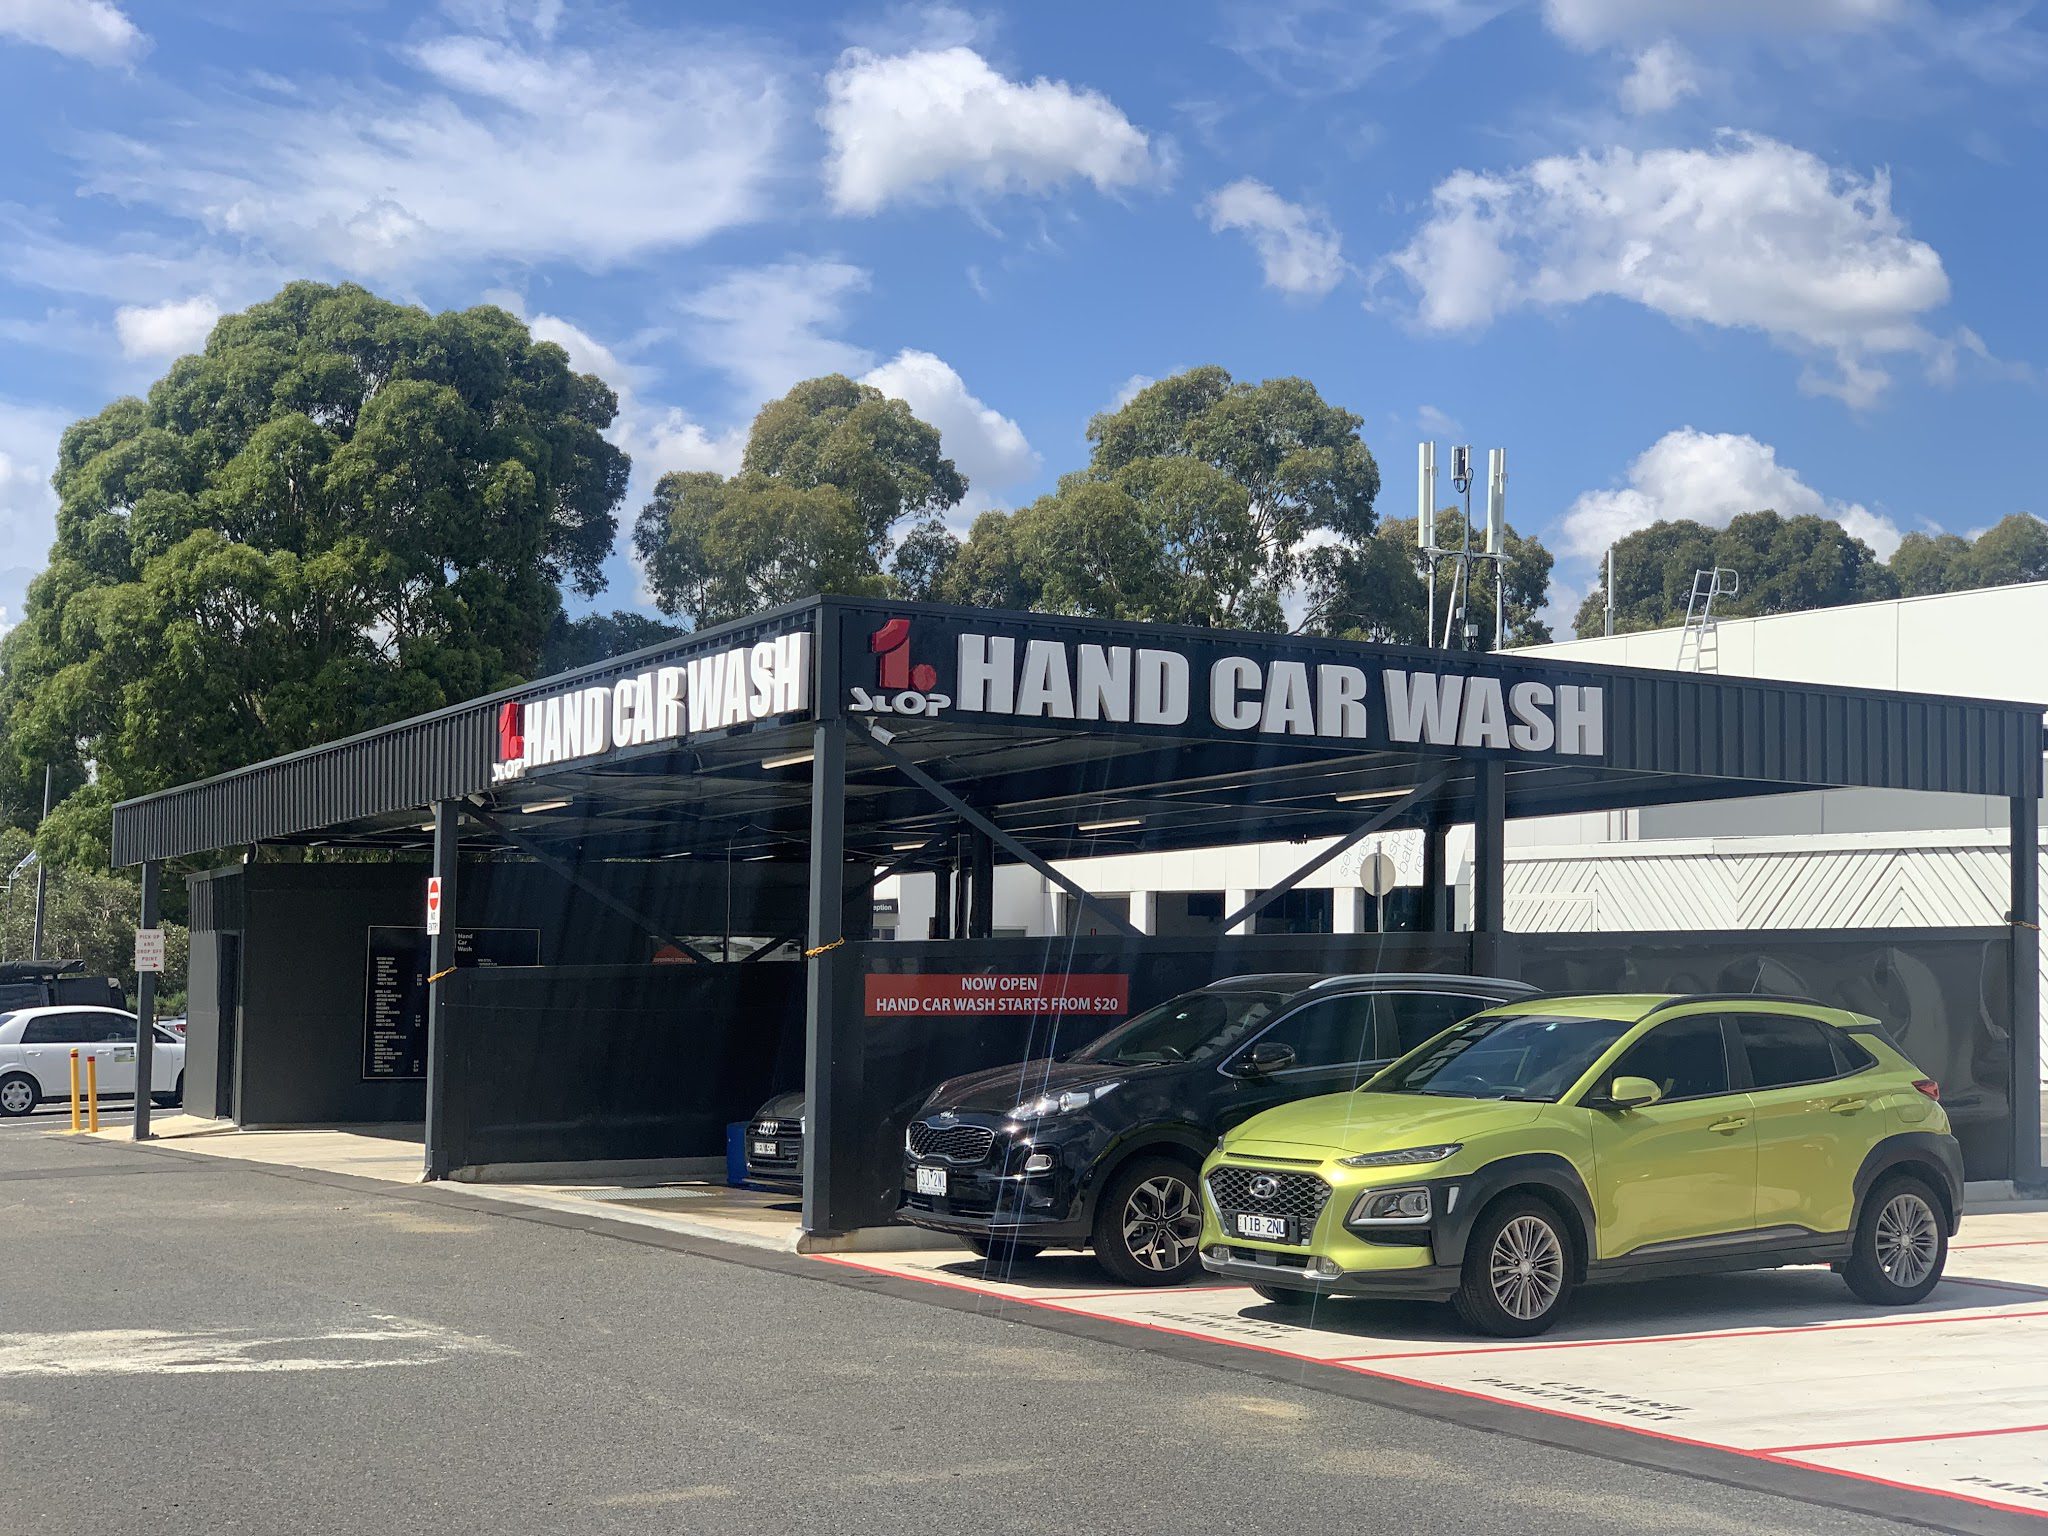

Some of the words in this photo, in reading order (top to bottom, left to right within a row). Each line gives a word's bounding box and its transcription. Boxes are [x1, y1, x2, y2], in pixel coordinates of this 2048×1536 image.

[523, 686, 613, 768] HAND
[611, 666, 688, 749] CAR
[687, 632, 811, 733] WASH
[955, 633, 1190, 725] HAND
[1209, 656, 1367, 739] CAR
[1382, 668, 1604, 756] WASH
[873, 904, 892, 912] eption
[961, 977, 998, 991] NOW
[999, 977, 1038, 991] OPEN
[876, 997, 920, 1012] HAND
[922, 997, 951, 1012] CAR
[953, 997, 996, 1012] WASH
[998, 997, 1048, 1011] STARTS
[1051, 997, 1091, 1011] FROM
[1093, 996, 1118, 1011] $20
[1469, 1377, 1593, 1405] PARKING
[1595, 1404, 1686, 1421] ONLY
[1540, 1381, 1606, 1394] CAR
[1601, 1394, 1694, 1412] WASH
